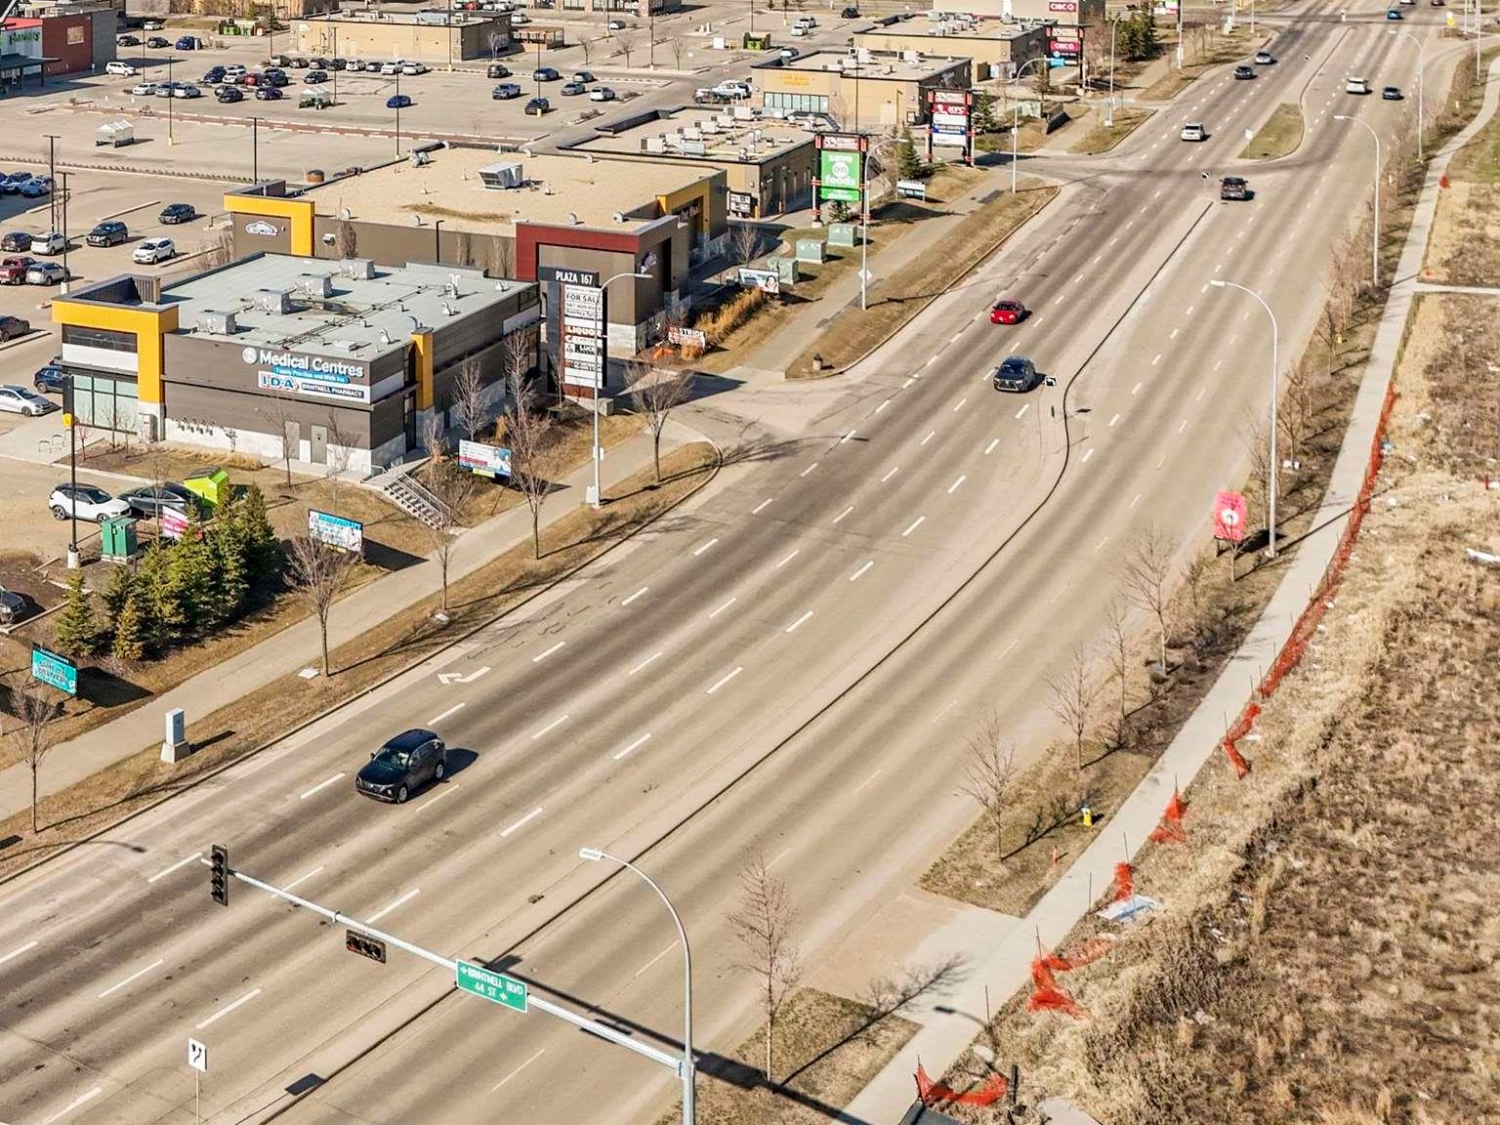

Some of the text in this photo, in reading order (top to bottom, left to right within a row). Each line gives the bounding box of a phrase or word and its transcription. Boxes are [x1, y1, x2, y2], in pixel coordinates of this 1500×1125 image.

[556, 271, 593, 285] PLAZA 167
[260, 350, 364, 377] Medical Centres
[487, 986, 497, 997] ST
